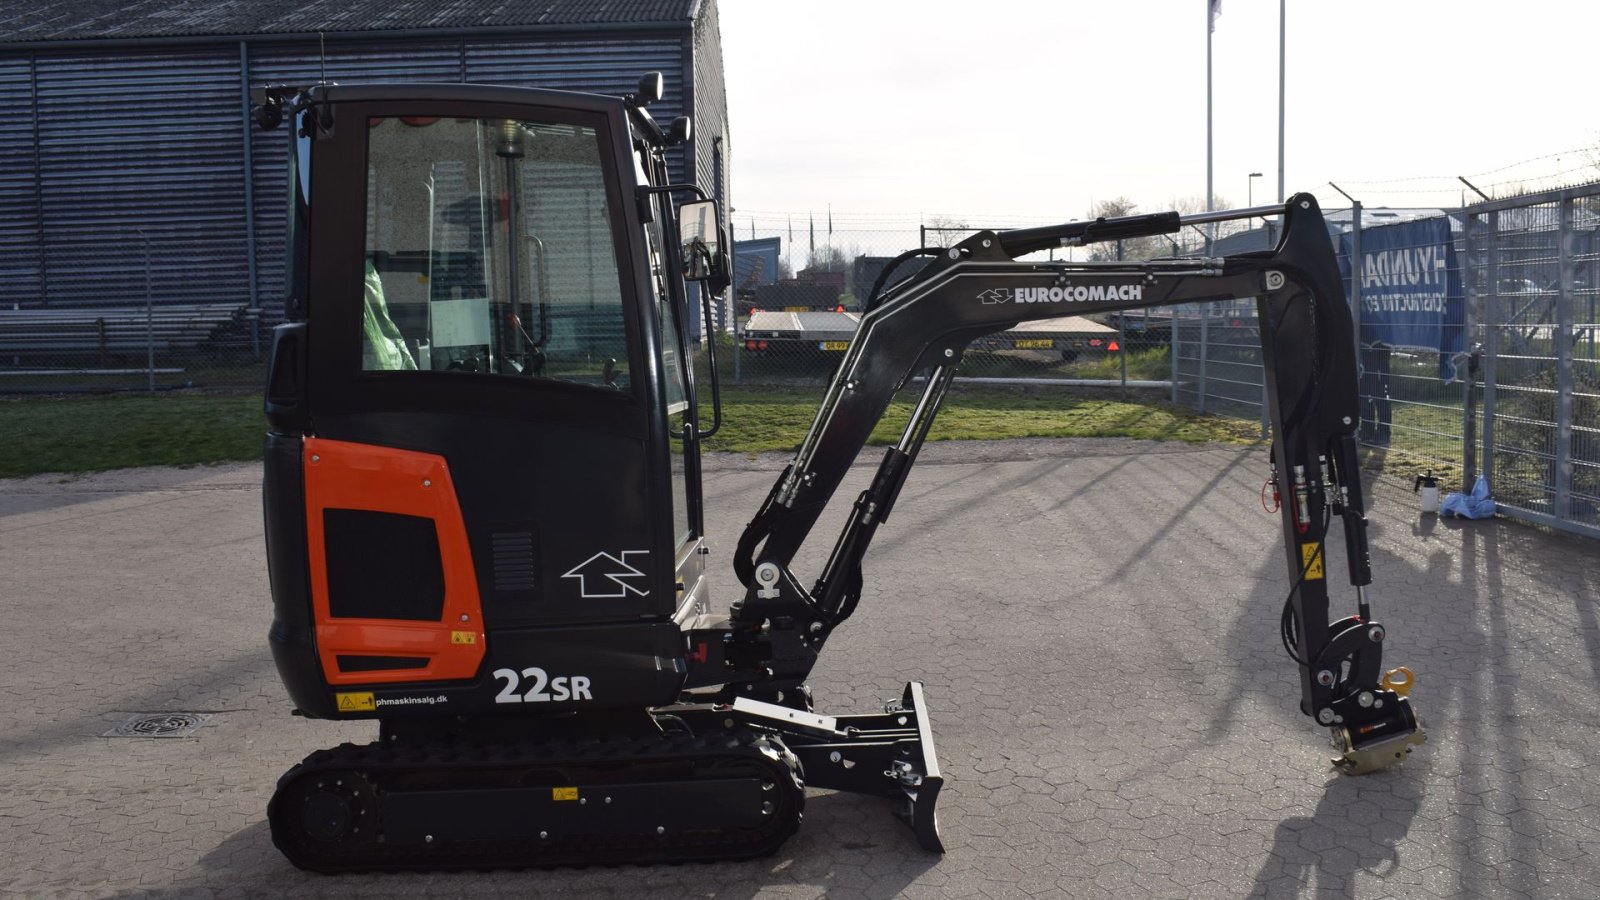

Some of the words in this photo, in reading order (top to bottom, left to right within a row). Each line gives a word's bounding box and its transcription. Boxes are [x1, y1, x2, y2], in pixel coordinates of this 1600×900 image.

[1014, 284, 1143, 304] EUROCOMACH
[492, 667, 593, 703] 22SR
[376, 695, 448, 708] phmaskinsalg.dk
